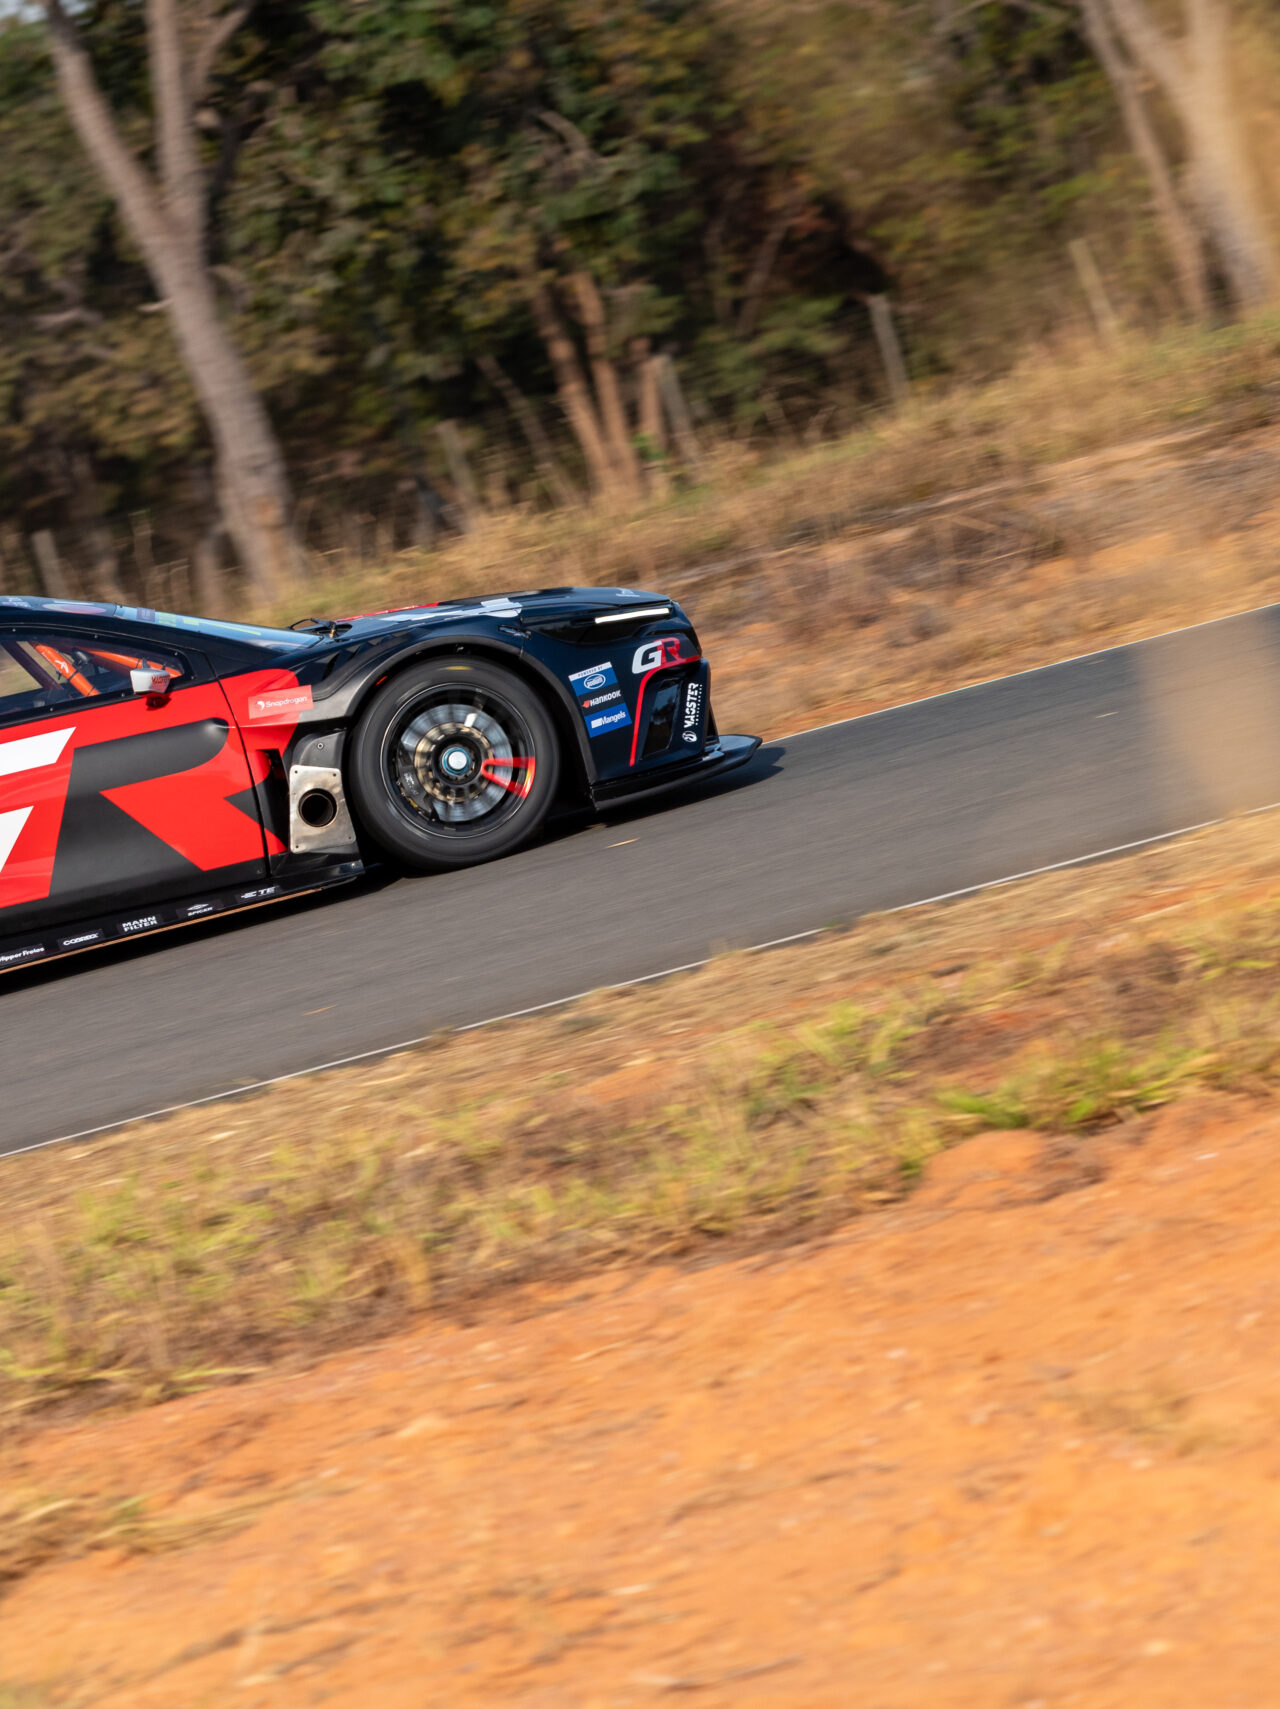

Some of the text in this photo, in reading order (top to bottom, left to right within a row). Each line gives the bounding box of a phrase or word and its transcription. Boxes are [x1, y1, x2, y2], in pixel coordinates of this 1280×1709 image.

[631, 637, 683, 674] GR
[265, 695, 308, 709] Snapdragon
[122, 915, 157, 927] MANN
[123, 919, 158, 932] FILTER
